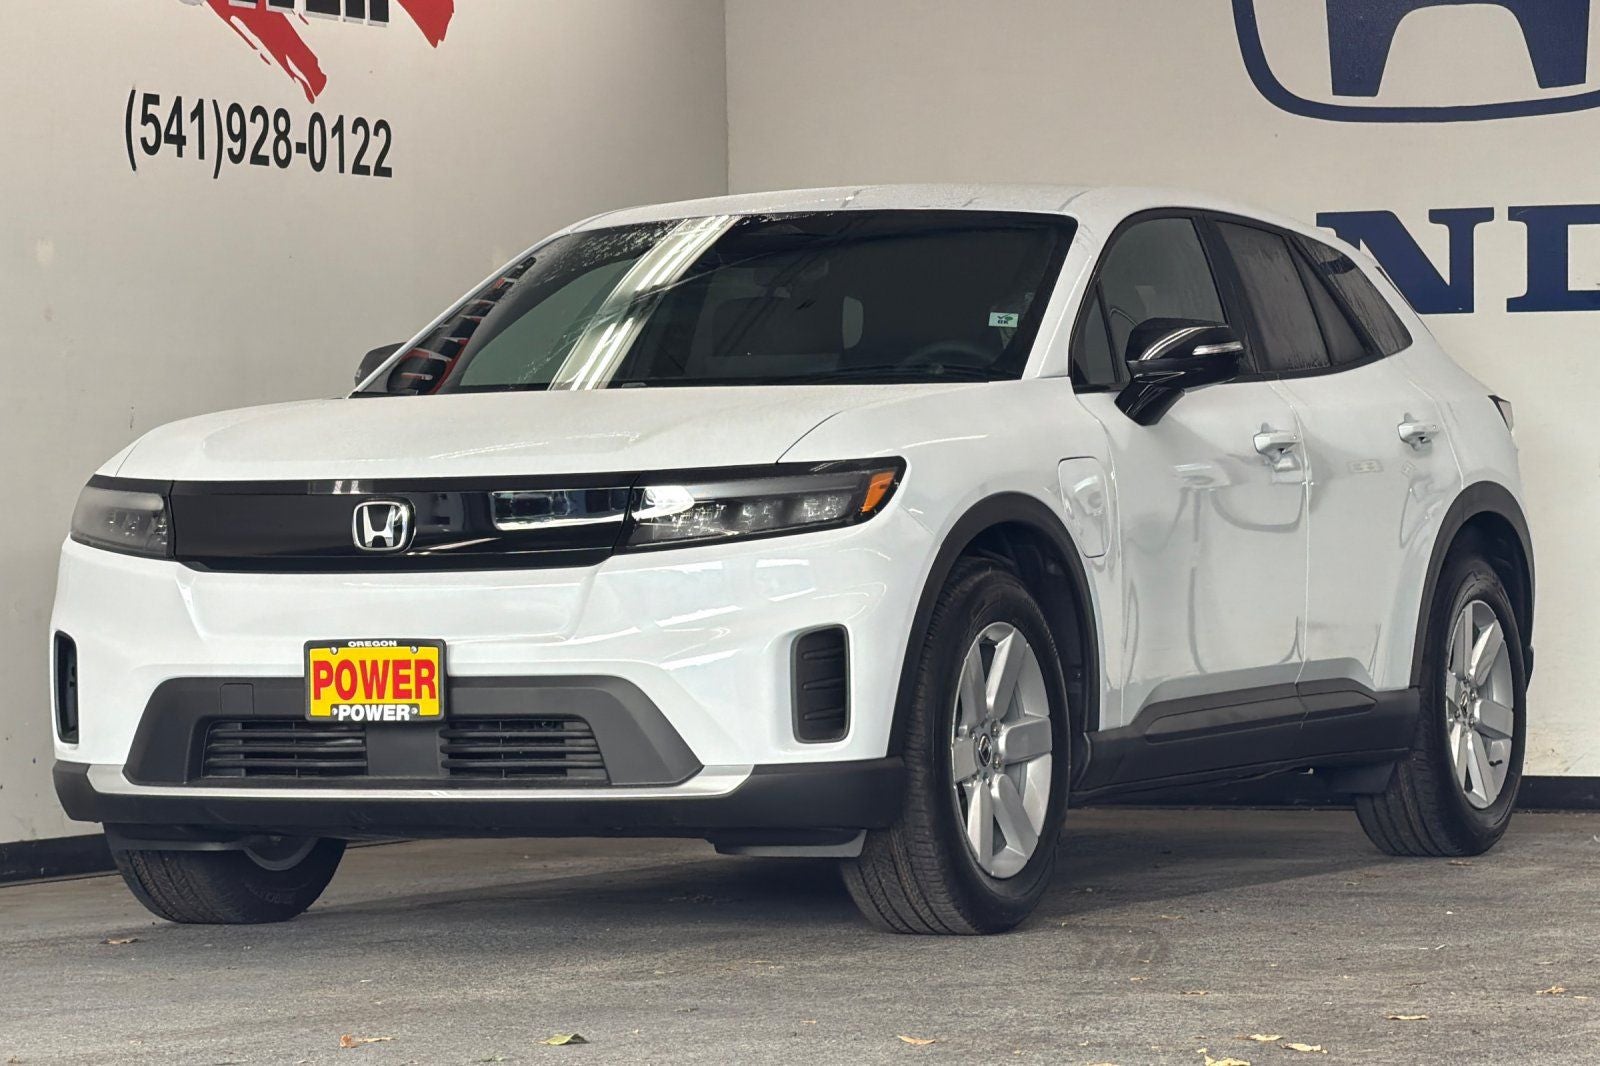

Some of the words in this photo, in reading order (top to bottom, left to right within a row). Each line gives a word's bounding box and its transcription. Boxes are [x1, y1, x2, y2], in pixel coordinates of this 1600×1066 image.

[125, 87, 394, 180] (541)928-0122
[347, 640, 397, 648] OREGON
[312, 658, 437, 701] POWER
[337, 704, 410, 722] POWER
